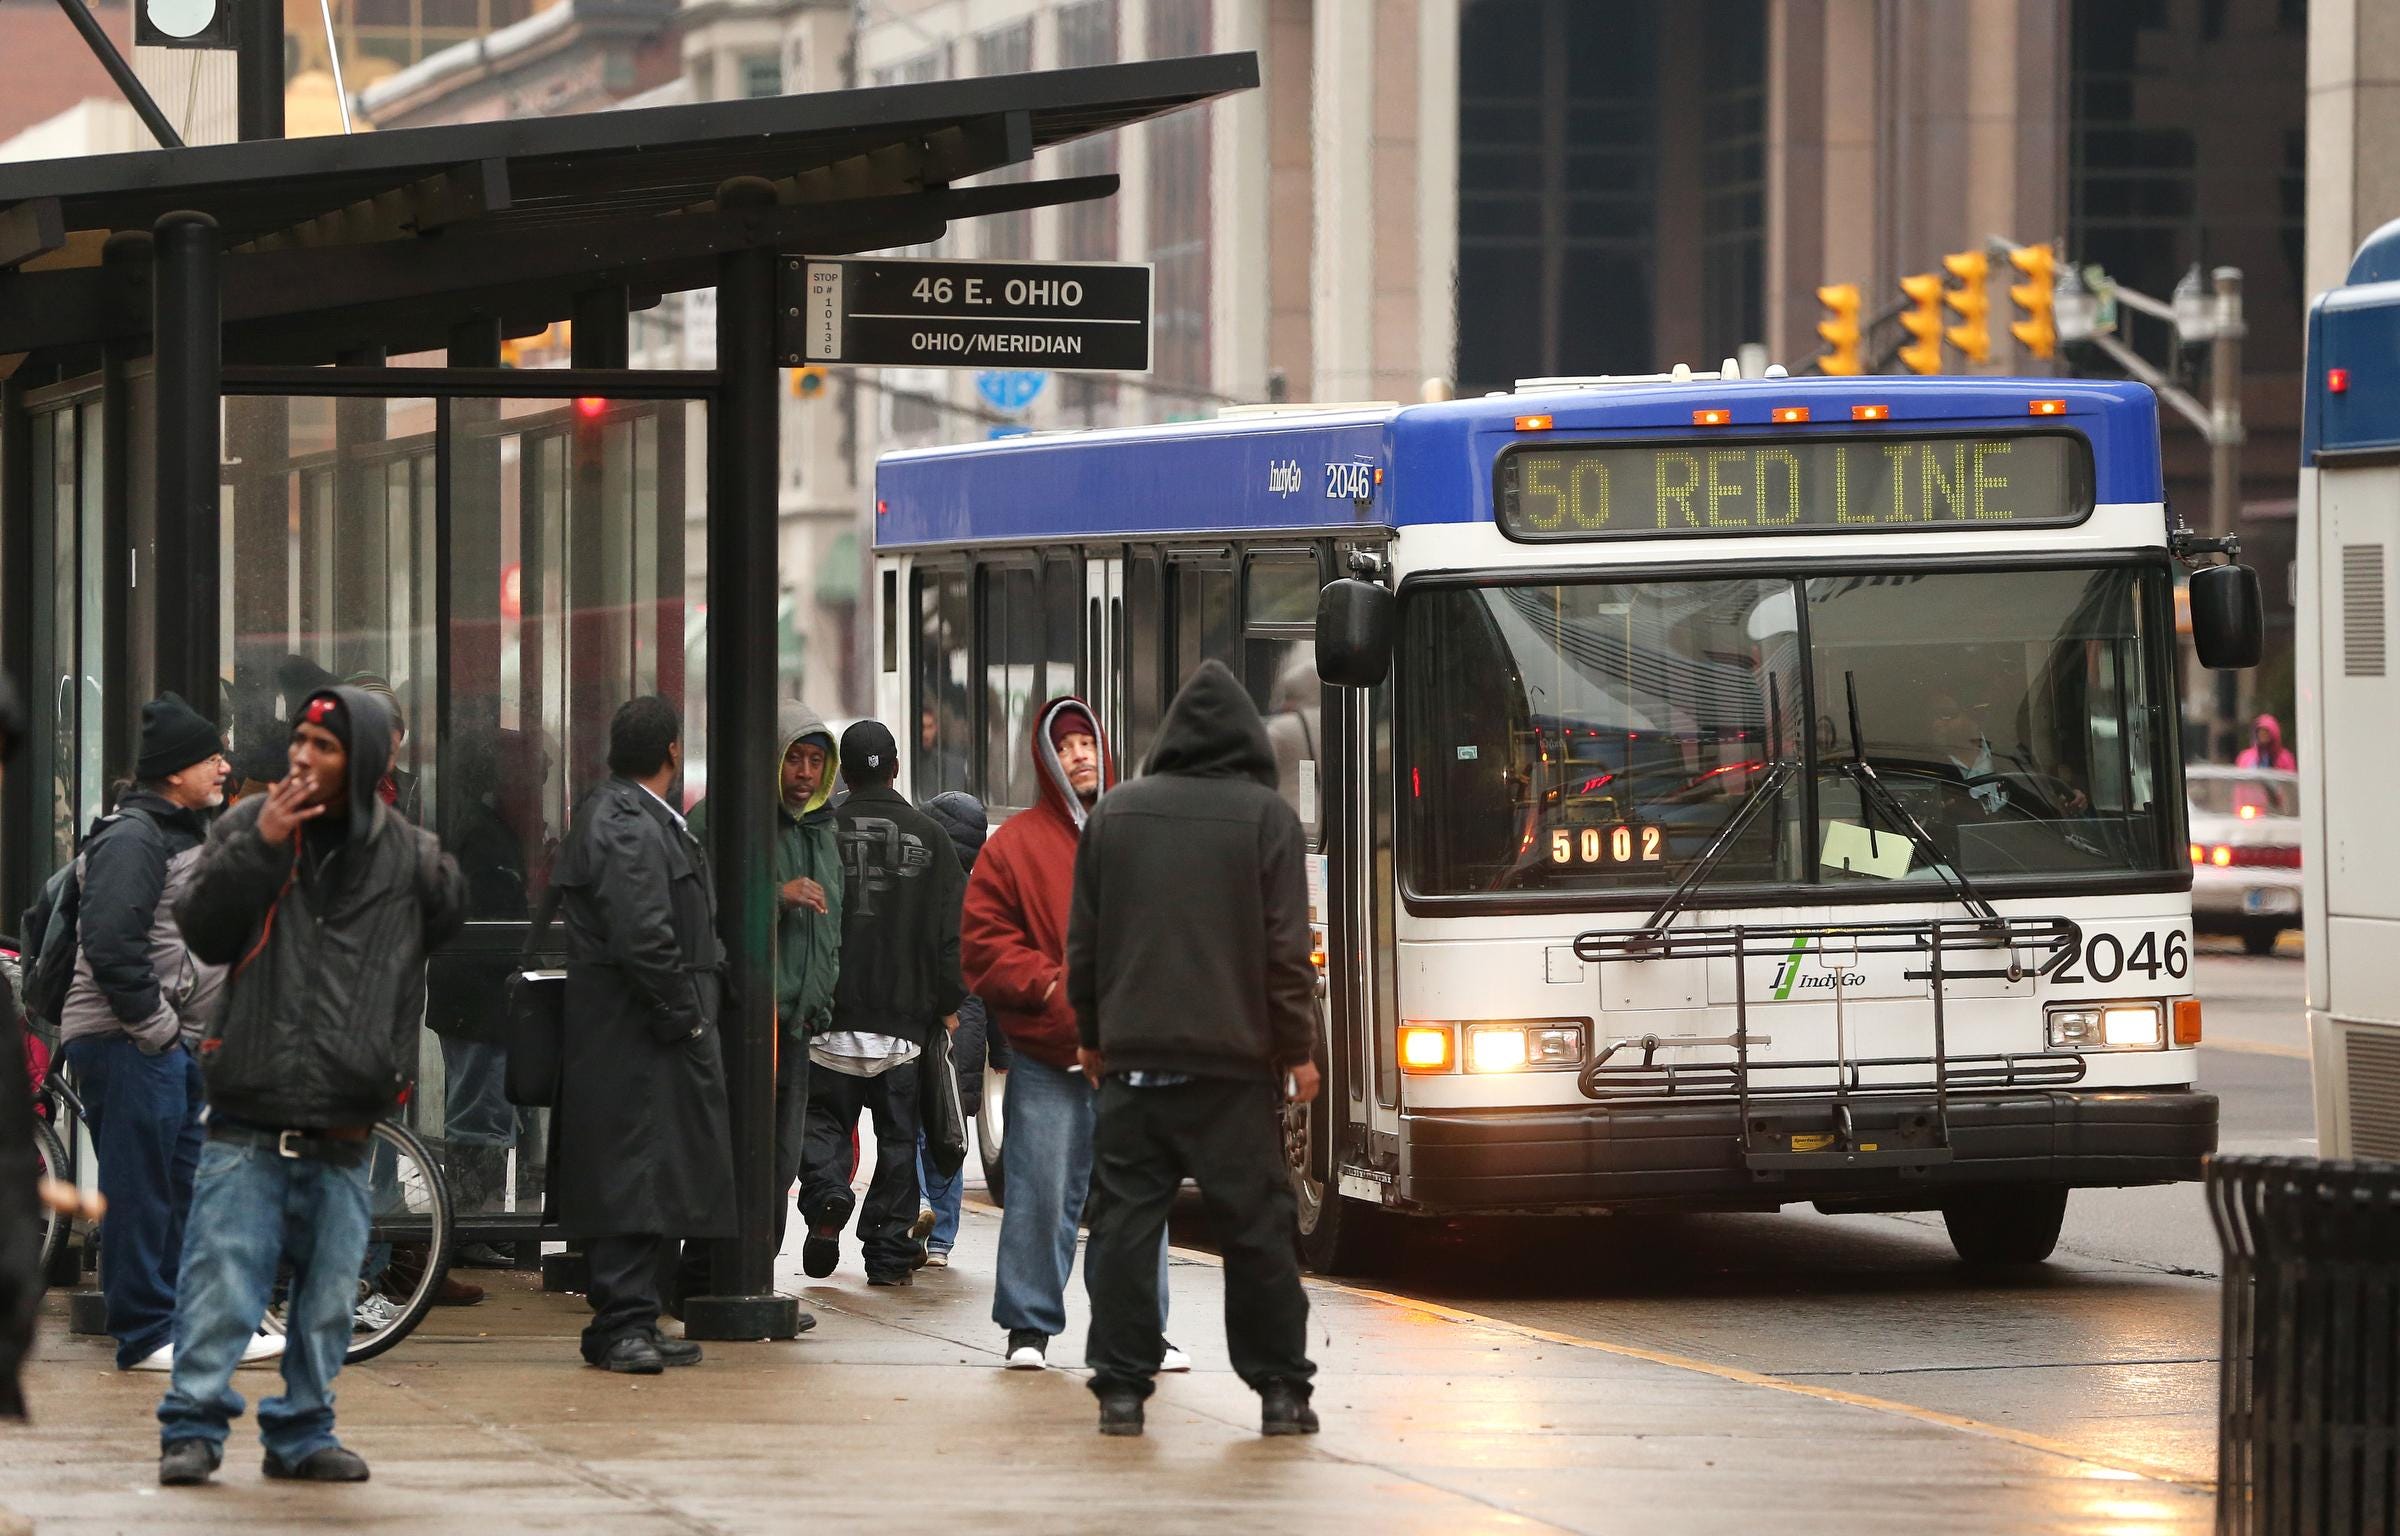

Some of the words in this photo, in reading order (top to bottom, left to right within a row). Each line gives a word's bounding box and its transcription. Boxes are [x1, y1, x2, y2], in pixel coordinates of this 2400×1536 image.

[813, 273, 838, 281] STOP
[813, 286, 823, 294] ID
[826, 286, 832, 294] #
[912, 277, 953, 303] 46
[965, 278, 992, 304] E.
[1004, 279, 1083, 307] OHIO
[911, 332, 1081, 355] OHIO/MERIDIAN
[1269, 460, 1301, 499] IndyGo
[1326, 464, 1369, 498] 2046
[1528, 459, 1609, 529] 50
[1656, 449, 1799, 529] RED
[1836, 442, 2012, 524] LINE
[1552, 826, 1660, 864] 5002
[2050, 929, 2188, 984] 2046
[1799, 972, 1866, 990] IndyGo
